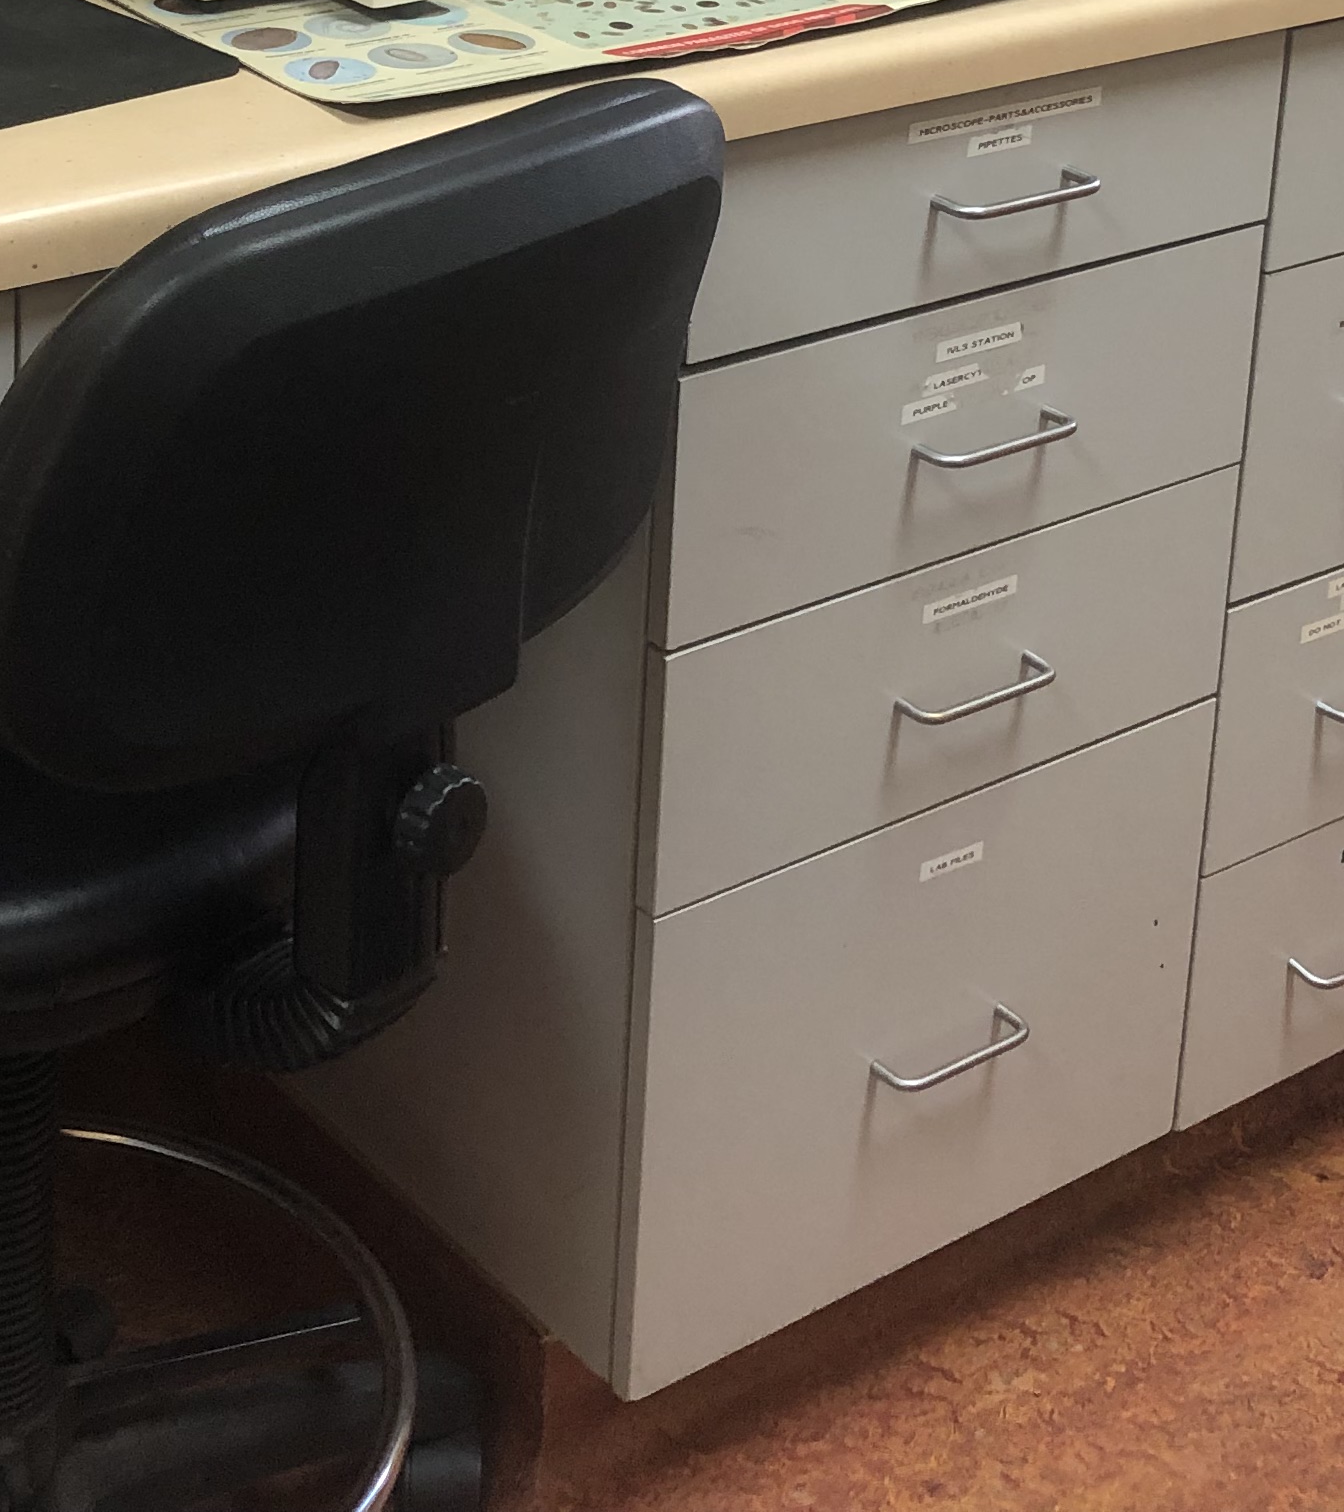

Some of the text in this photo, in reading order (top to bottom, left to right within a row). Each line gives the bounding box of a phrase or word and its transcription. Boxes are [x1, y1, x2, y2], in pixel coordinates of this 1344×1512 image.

[920, 94, 1092, 136] MICROSCOPE-PARTS&ACCESSORIES
[978, 134, 1023, 150] PIPETTES
[971, 331, 1015, 349] STATION
[913, 400, 948, 417] PURPLE
[934, 584, 1009, 616] FORMALDEHYDE
[1308, 626, 1321, 637] DO
[1323, 619, 1340, 631] NOT
[930, 851, 974, 874] LAB FILES
